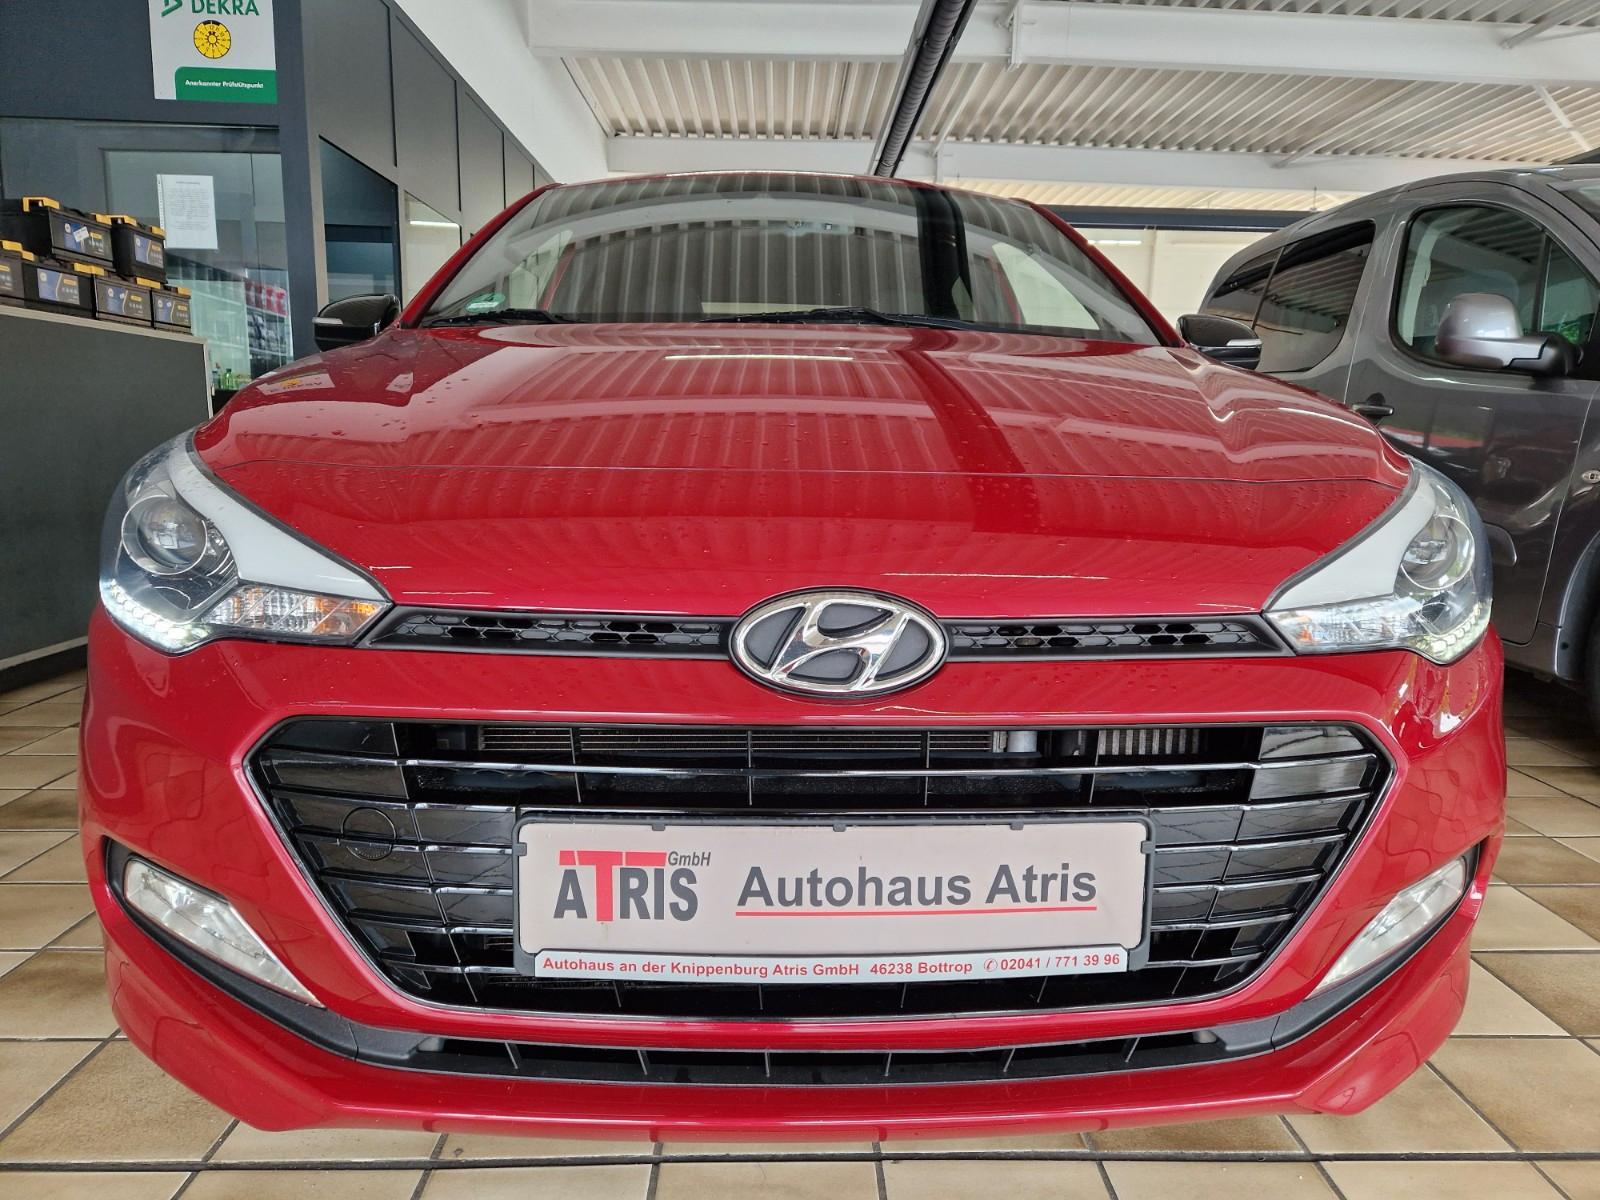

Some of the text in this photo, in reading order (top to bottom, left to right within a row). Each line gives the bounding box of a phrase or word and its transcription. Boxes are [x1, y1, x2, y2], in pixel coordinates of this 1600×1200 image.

[191, 0, 260, 16] DEKRA
[553, 850, 711, 922] ATRIS GmbH
[736, 862, 1097, 907] Autohaus Atris
[542, 953, 1121, 978] Autohaus an der Knippenburg Atris GmbH 46238 Bottrop 02041 / 771 39 96
